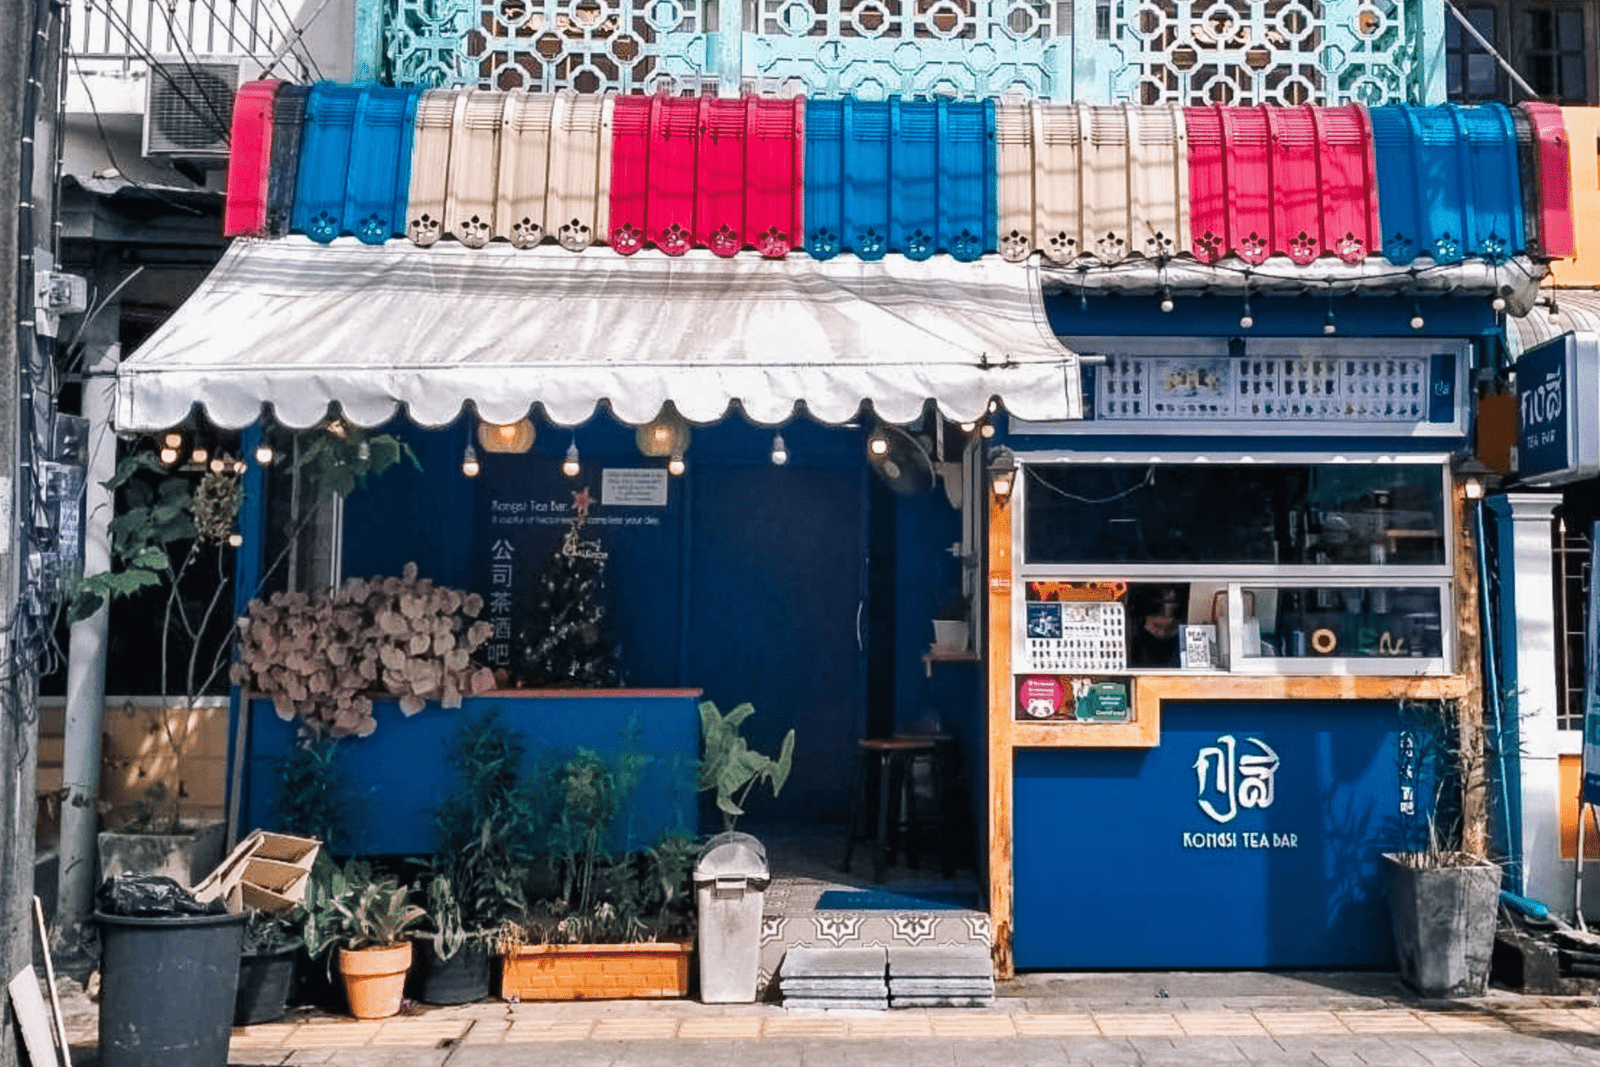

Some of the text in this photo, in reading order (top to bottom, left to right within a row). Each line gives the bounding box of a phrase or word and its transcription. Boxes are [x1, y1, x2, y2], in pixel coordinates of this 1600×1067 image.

[530, 500, 548, 512] Tea
[1183, 832, 1298, 848] KONGSI TEA BAR
